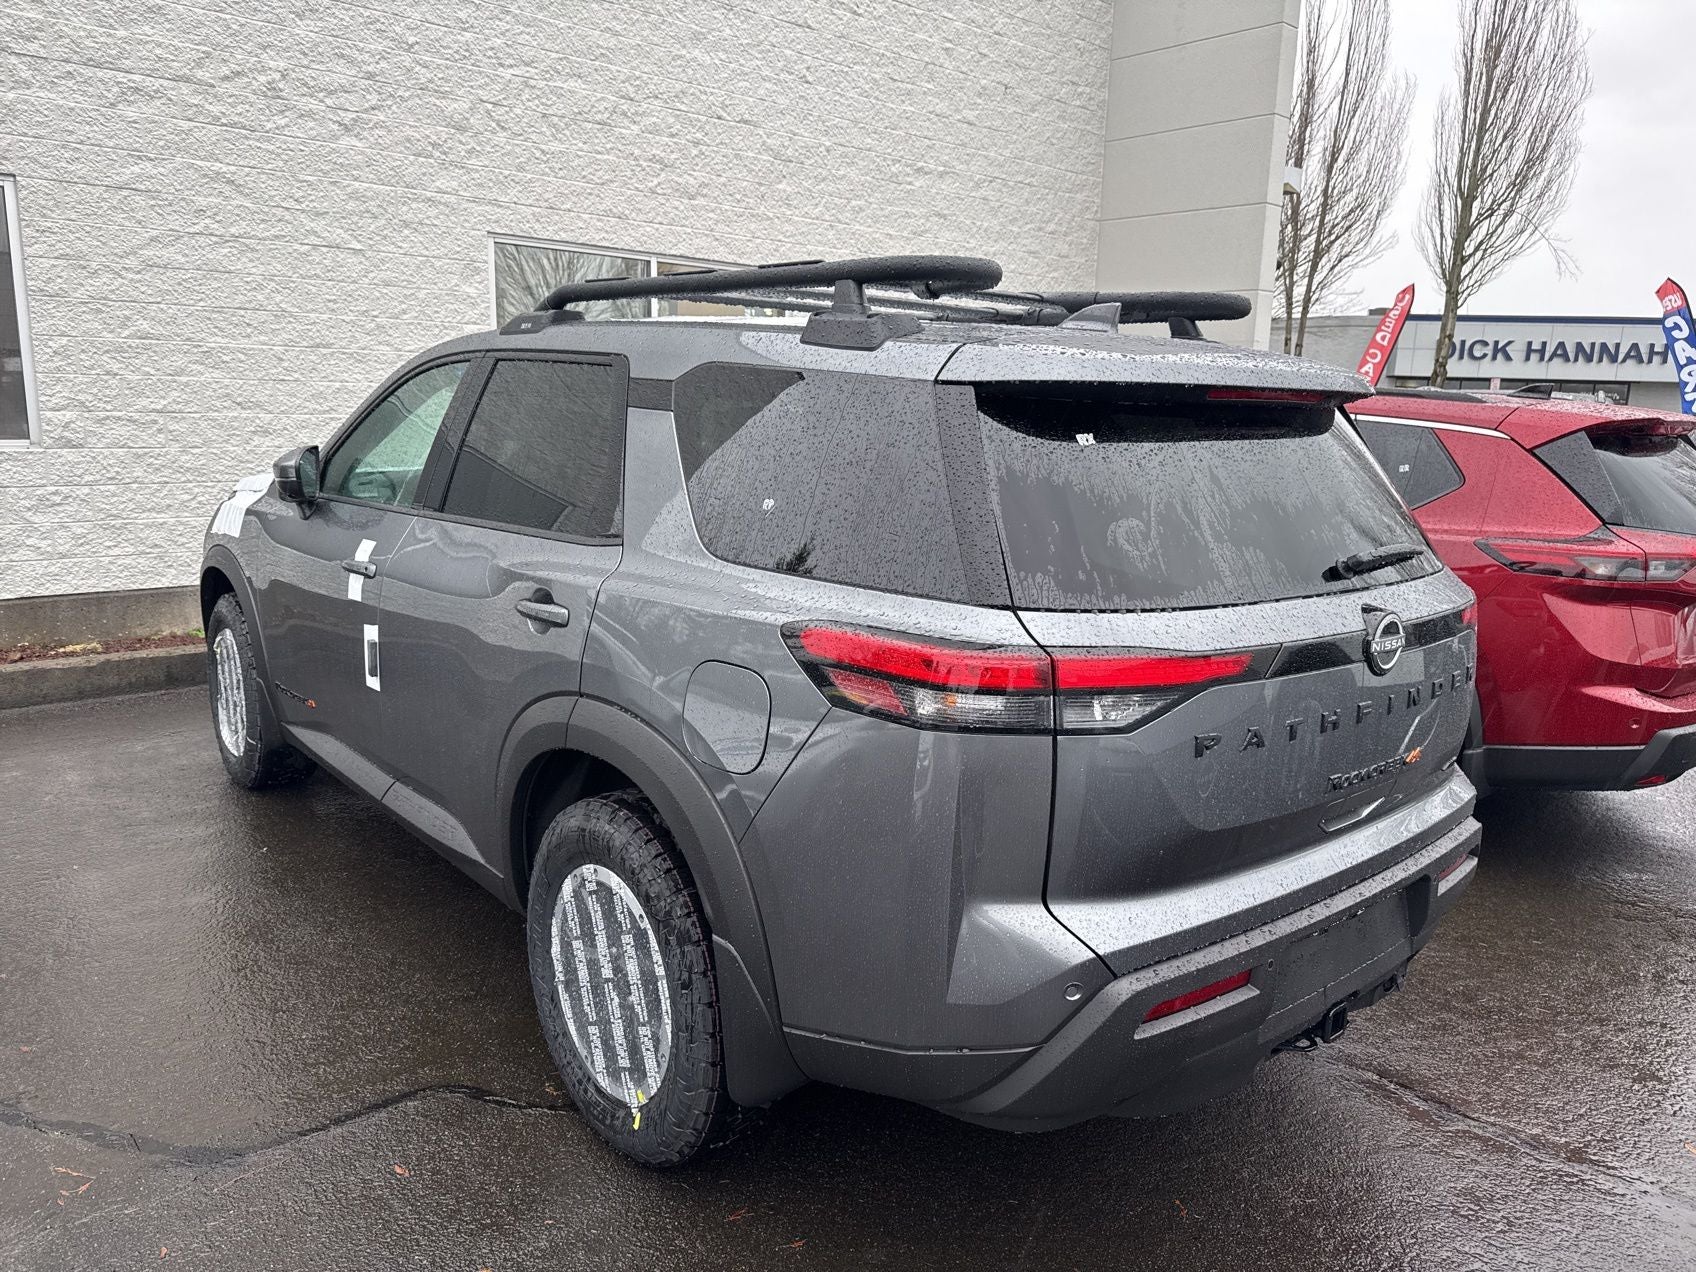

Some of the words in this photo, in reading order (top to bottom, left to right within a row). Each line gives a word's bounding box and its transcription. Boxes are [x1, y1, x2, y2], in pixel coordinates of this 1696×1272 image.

[1524, 340, 1670, 364] HANNAH
[1371, 637, 1405, 653] NISSAN
[1194, 663, 1474, 758] PATHFINDER
